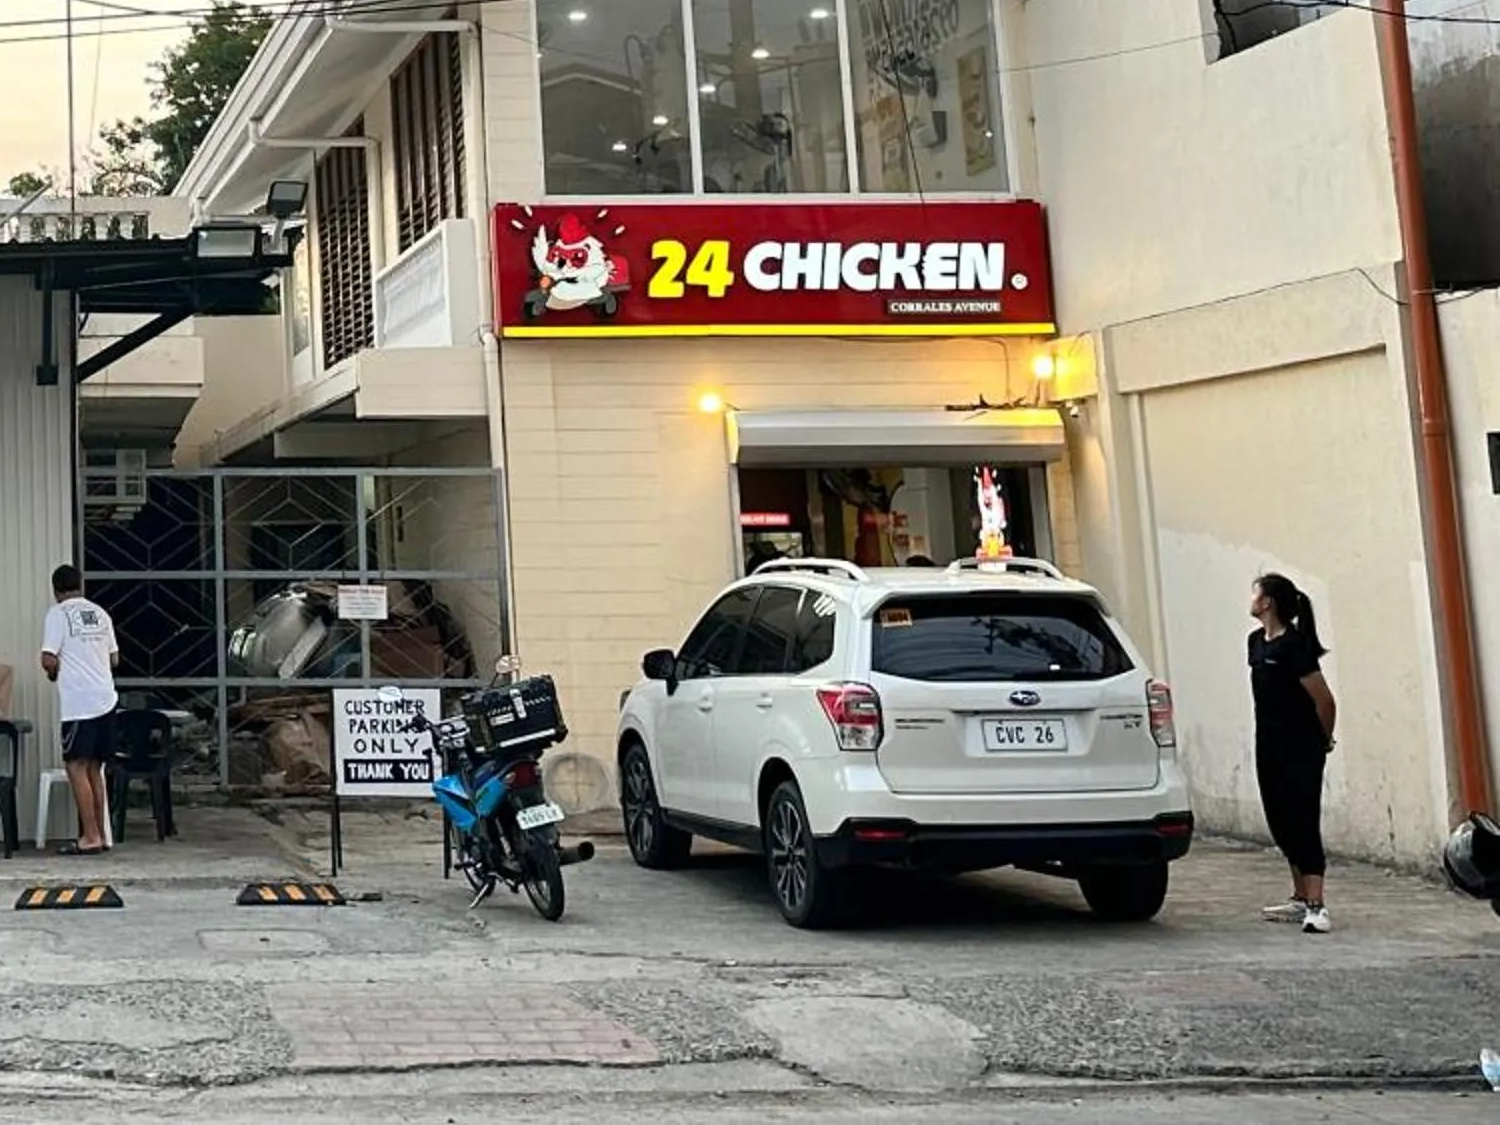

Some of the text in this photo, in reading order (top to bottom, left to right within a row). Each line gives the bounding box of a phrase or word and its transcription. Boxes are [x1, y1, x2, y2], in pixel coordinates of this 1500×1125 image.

[648, 240, 1005, 298] 24 CHICKEN
[891, 302, 1001, 313] CORRALES AVENUE
[344, 698, 425, 716] CUSTOMER
[995, 726, 1054, 744] CVC 26
[353, 738, 419, 754] ONLY
[347, 762, 429, 780] THANK YOU
